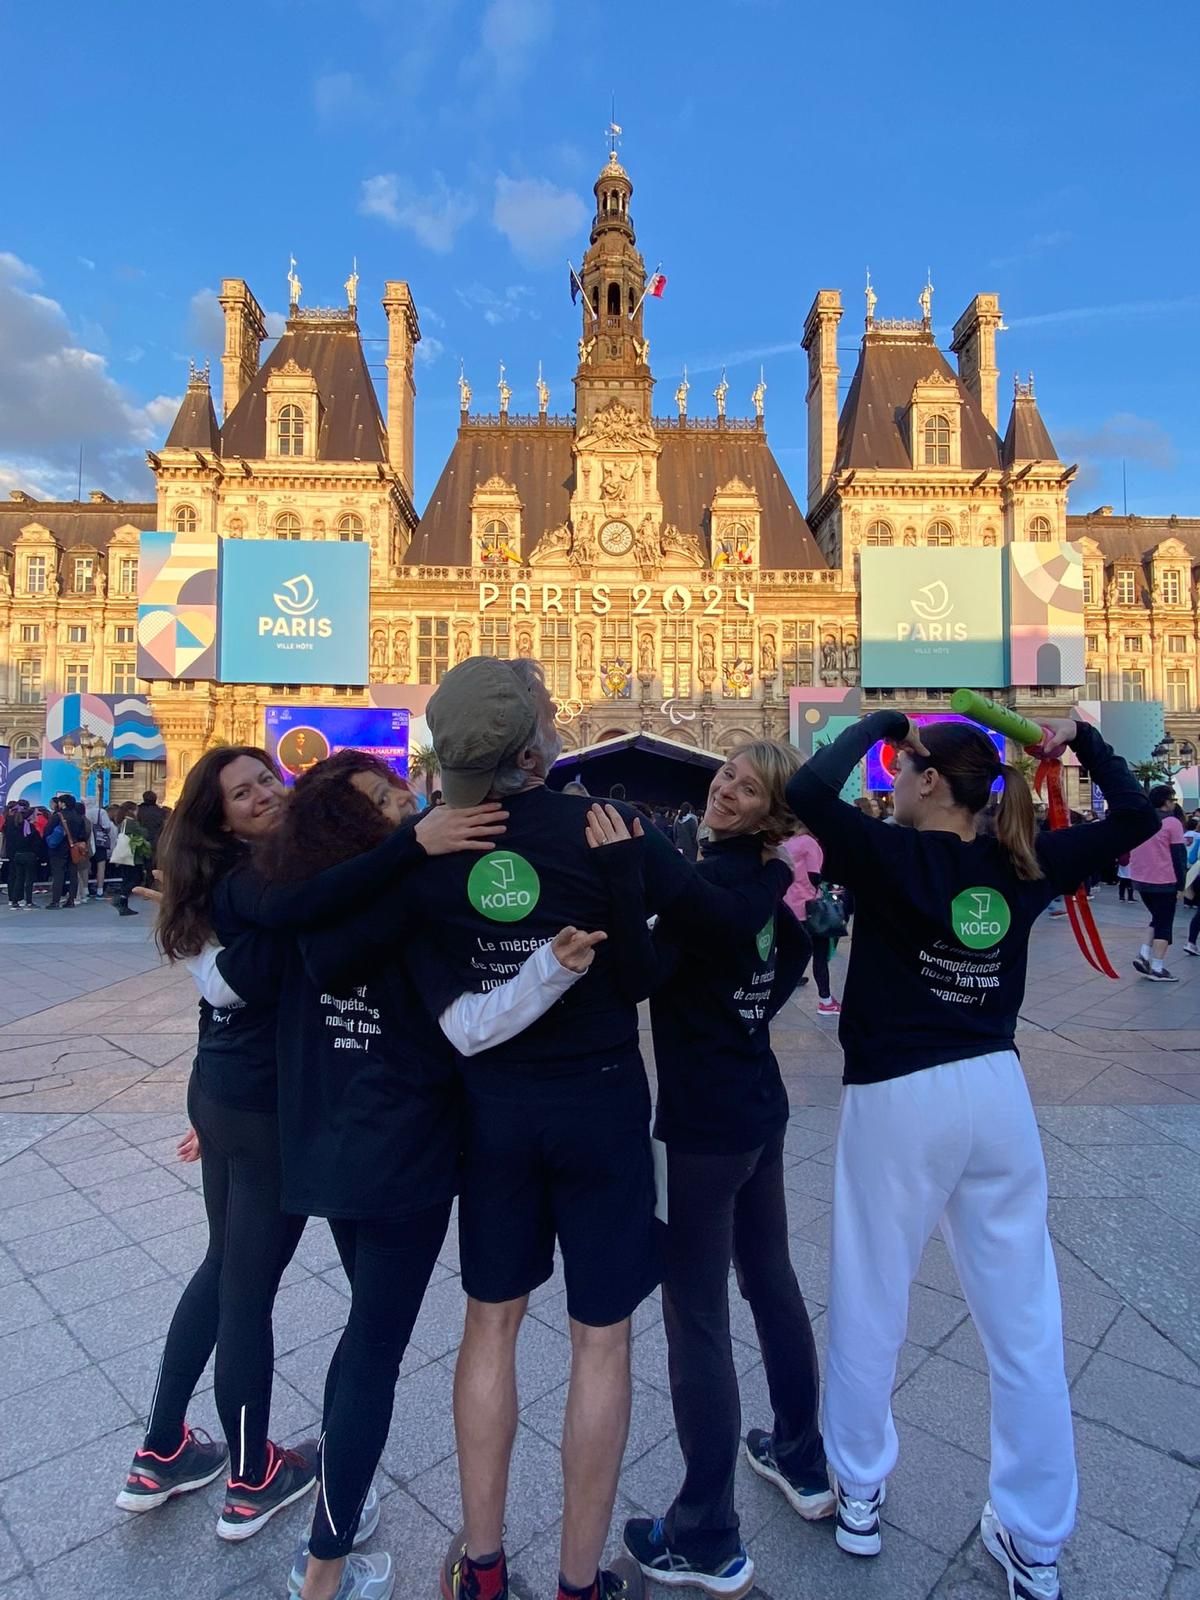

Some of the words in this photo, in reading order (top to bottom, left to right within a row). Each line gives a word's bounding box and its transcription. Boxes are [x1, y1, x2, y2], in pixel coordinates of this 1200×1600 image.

[632, 584, 755, 615] 2024
[258, 616, 332, 638] PARIS
[897, 622, 968, 641] PARIS
[481, 890, 531, 909] KOEO
[960, 922, 1001, 935] KOEO
[477, 937, 497, 952] Le
[920, 966, 952, 983] nous
[954, 972, 974, 988] fait
[975, 975, 1000, 988] tous
[358, 1020, 382, 1035] tous
